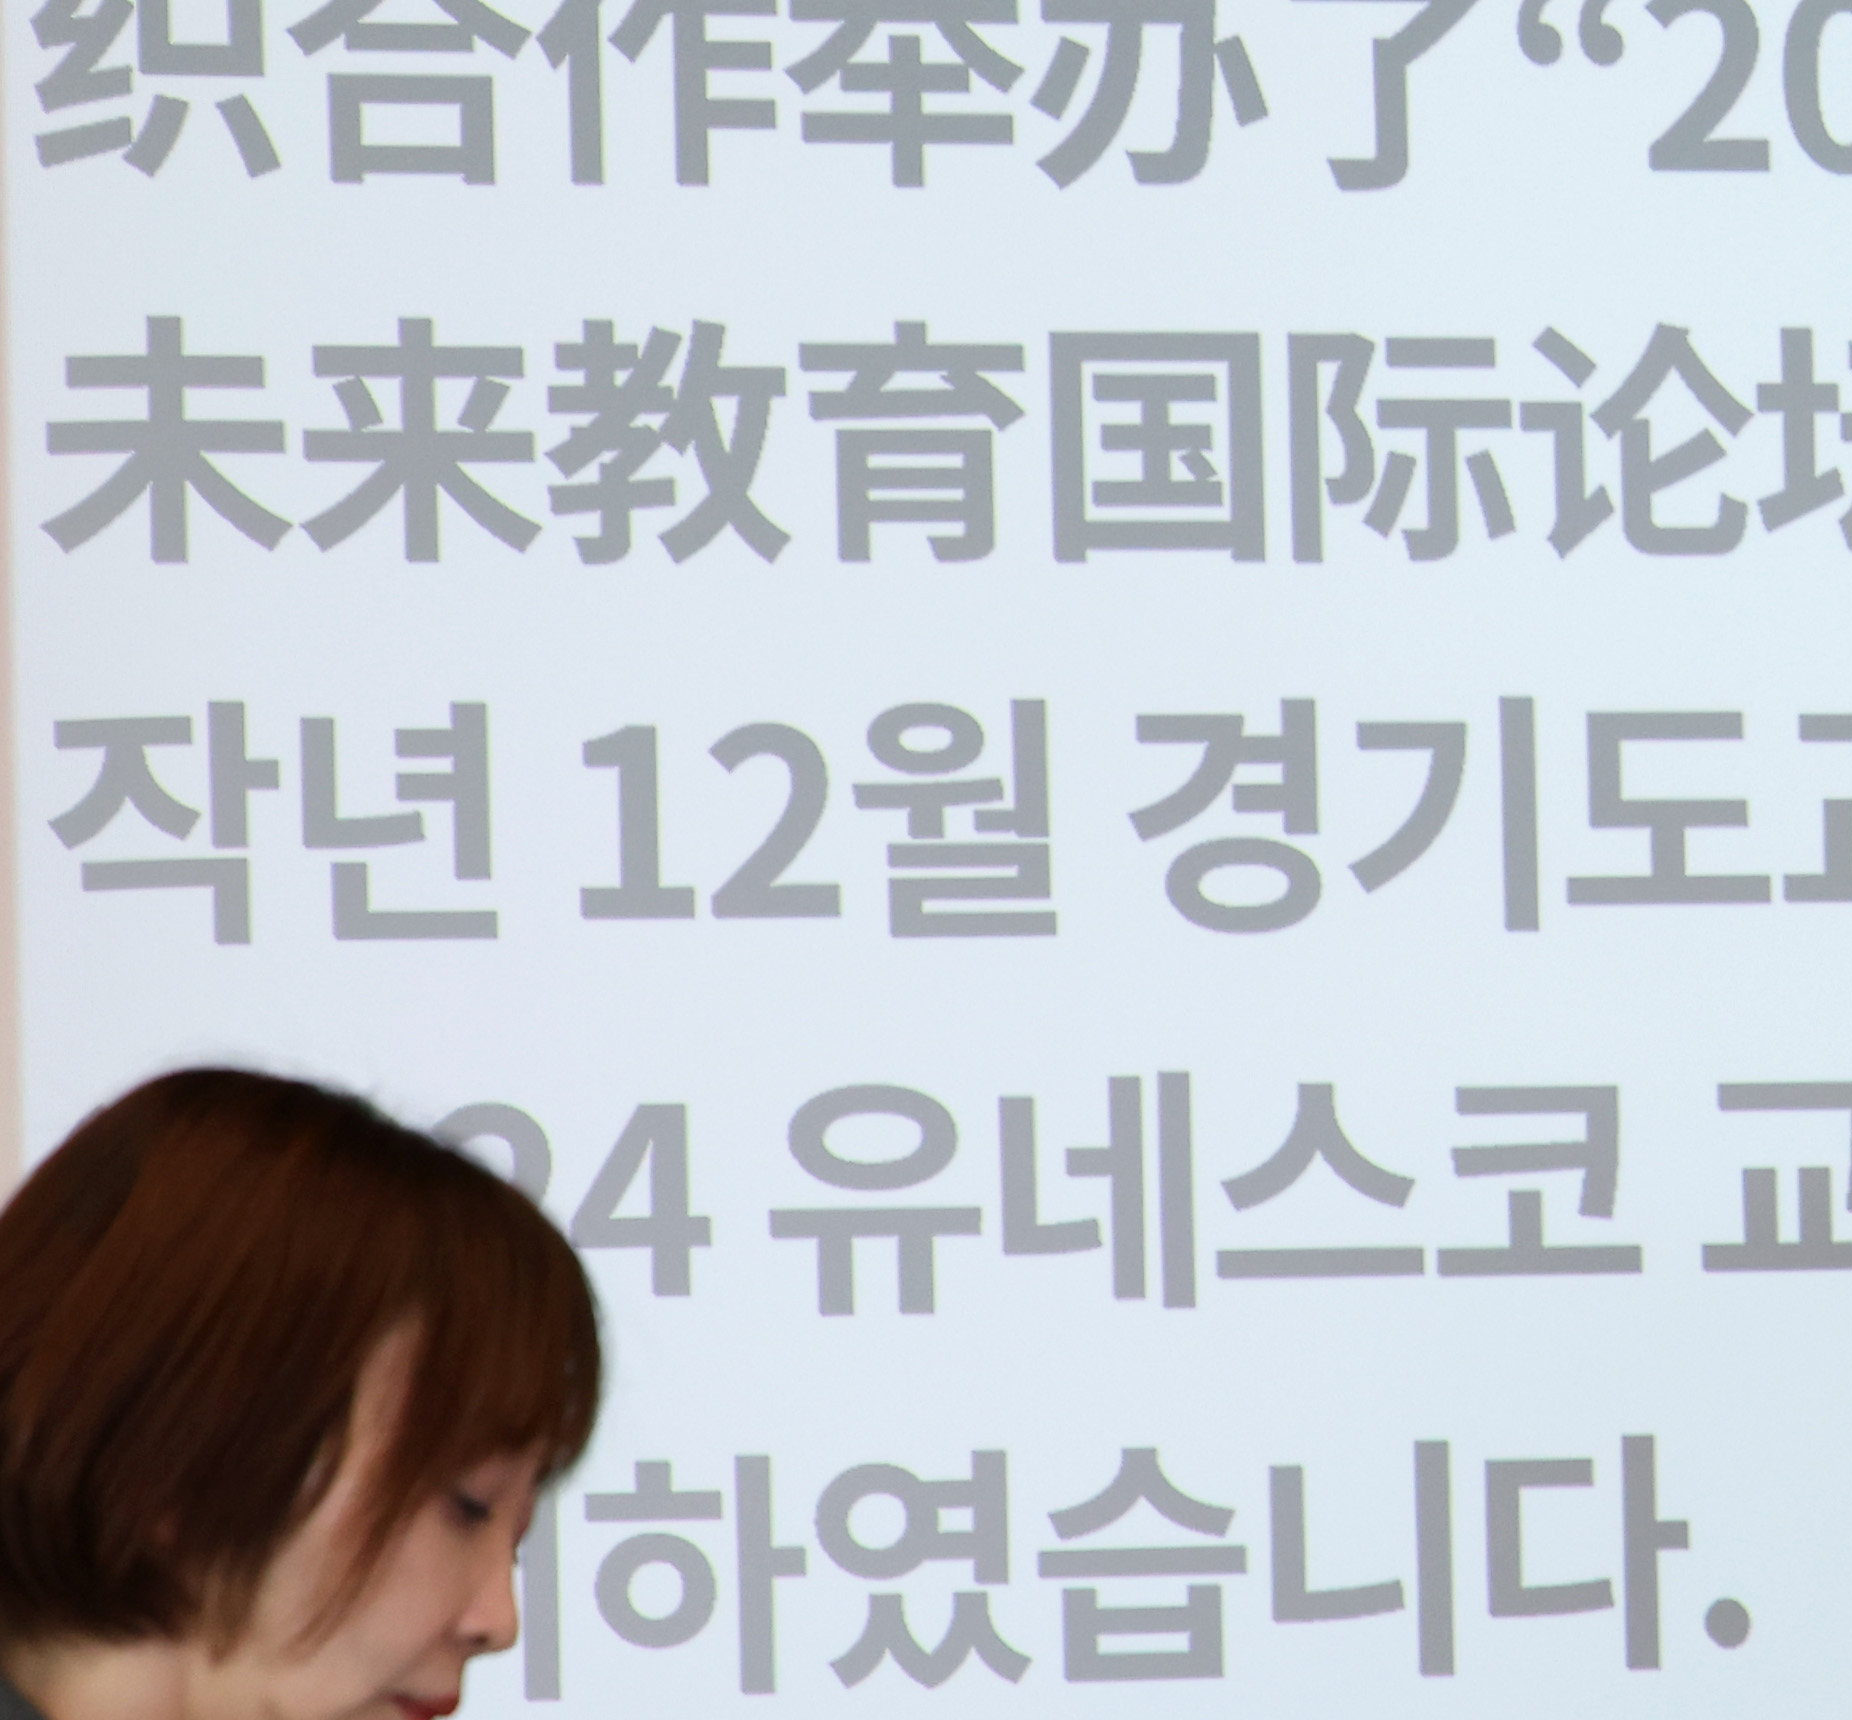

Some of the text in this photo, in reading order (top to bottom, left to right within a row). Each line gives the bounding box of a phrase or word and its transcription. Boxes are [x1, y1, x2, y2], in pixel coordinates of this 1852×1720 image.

[48, 700, 500, 945] 작년
[579, 697, 1058, 939] 12월
[768, 1070, 1644, 1317] 유네스코
